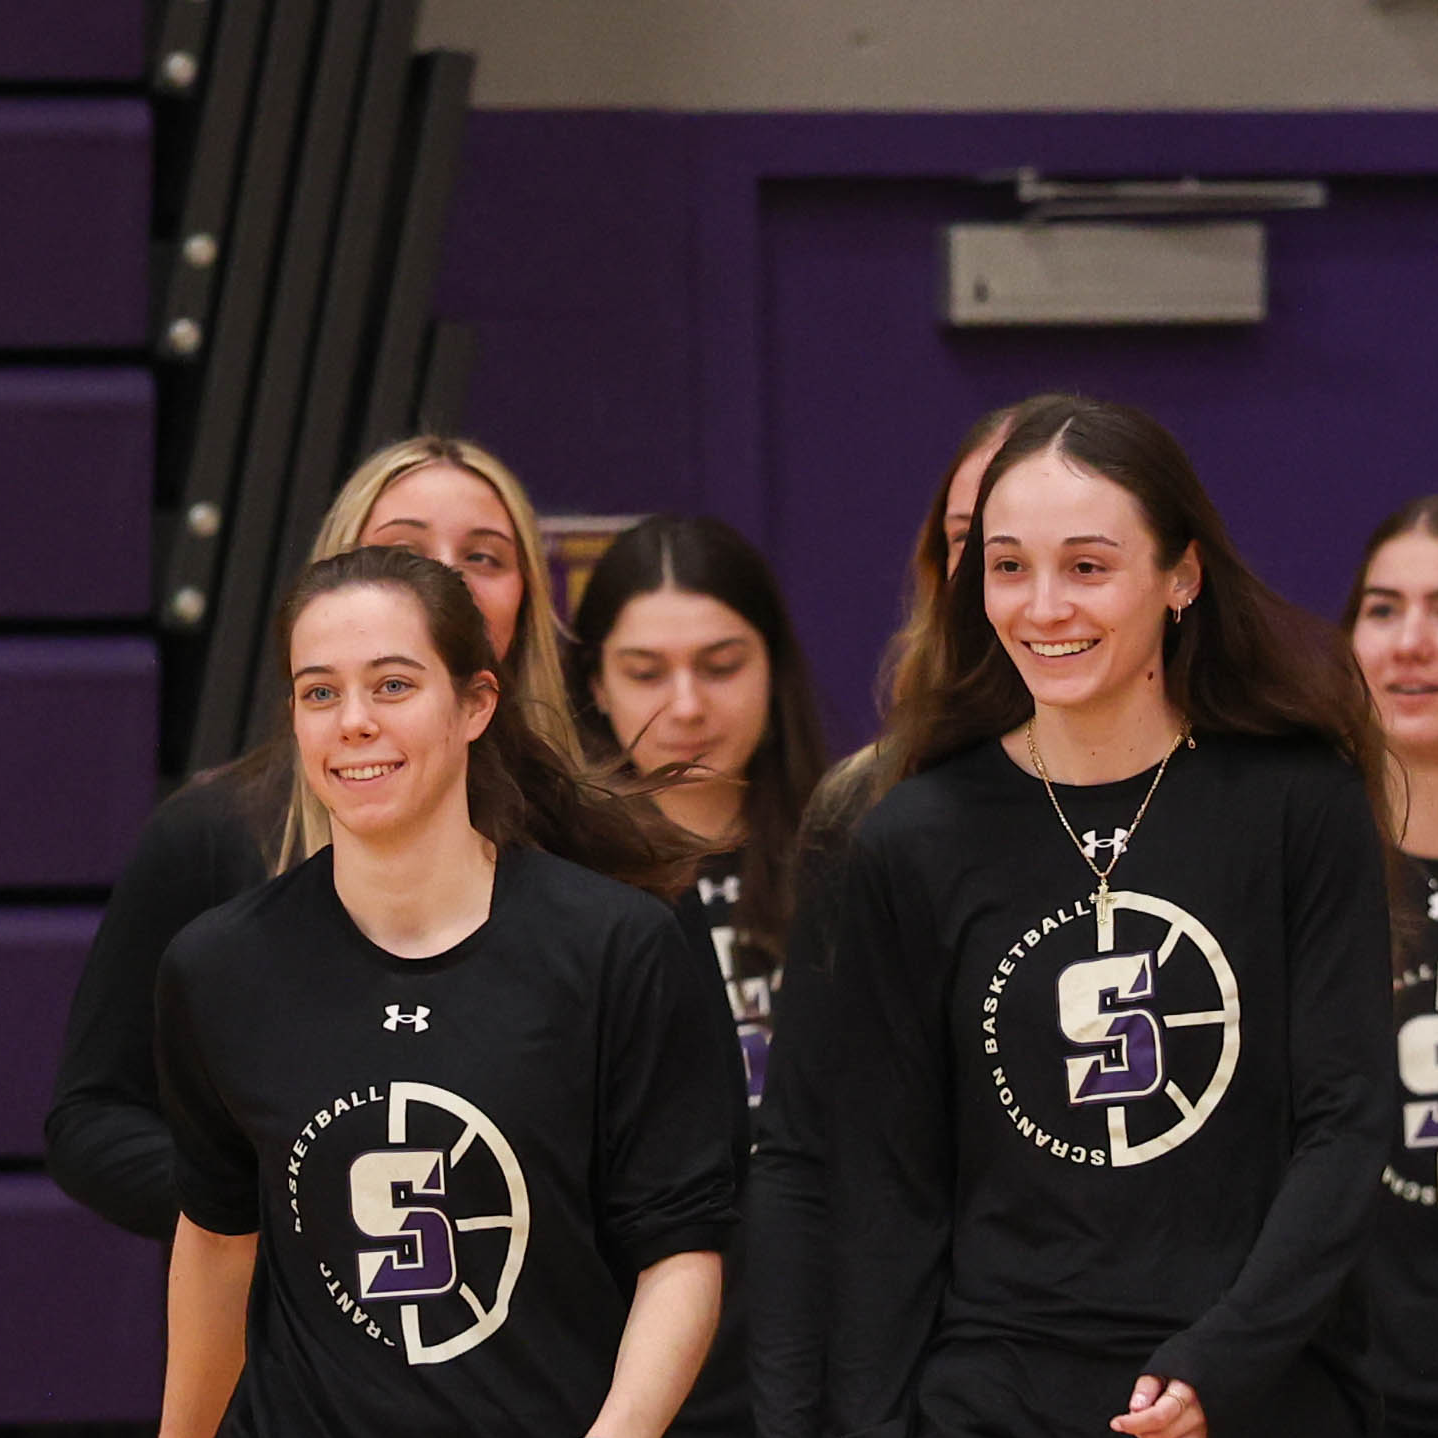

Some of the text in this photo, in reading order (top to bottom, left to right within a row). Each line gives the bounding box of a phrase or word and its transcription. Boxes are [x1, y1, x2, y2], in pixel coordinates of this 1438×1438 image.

[982, 900, 1106, 1166] SCRANTON BASKETBALL
[1055, 951, 1164, 1106] S
[348, 1148, 457, 1300] S
